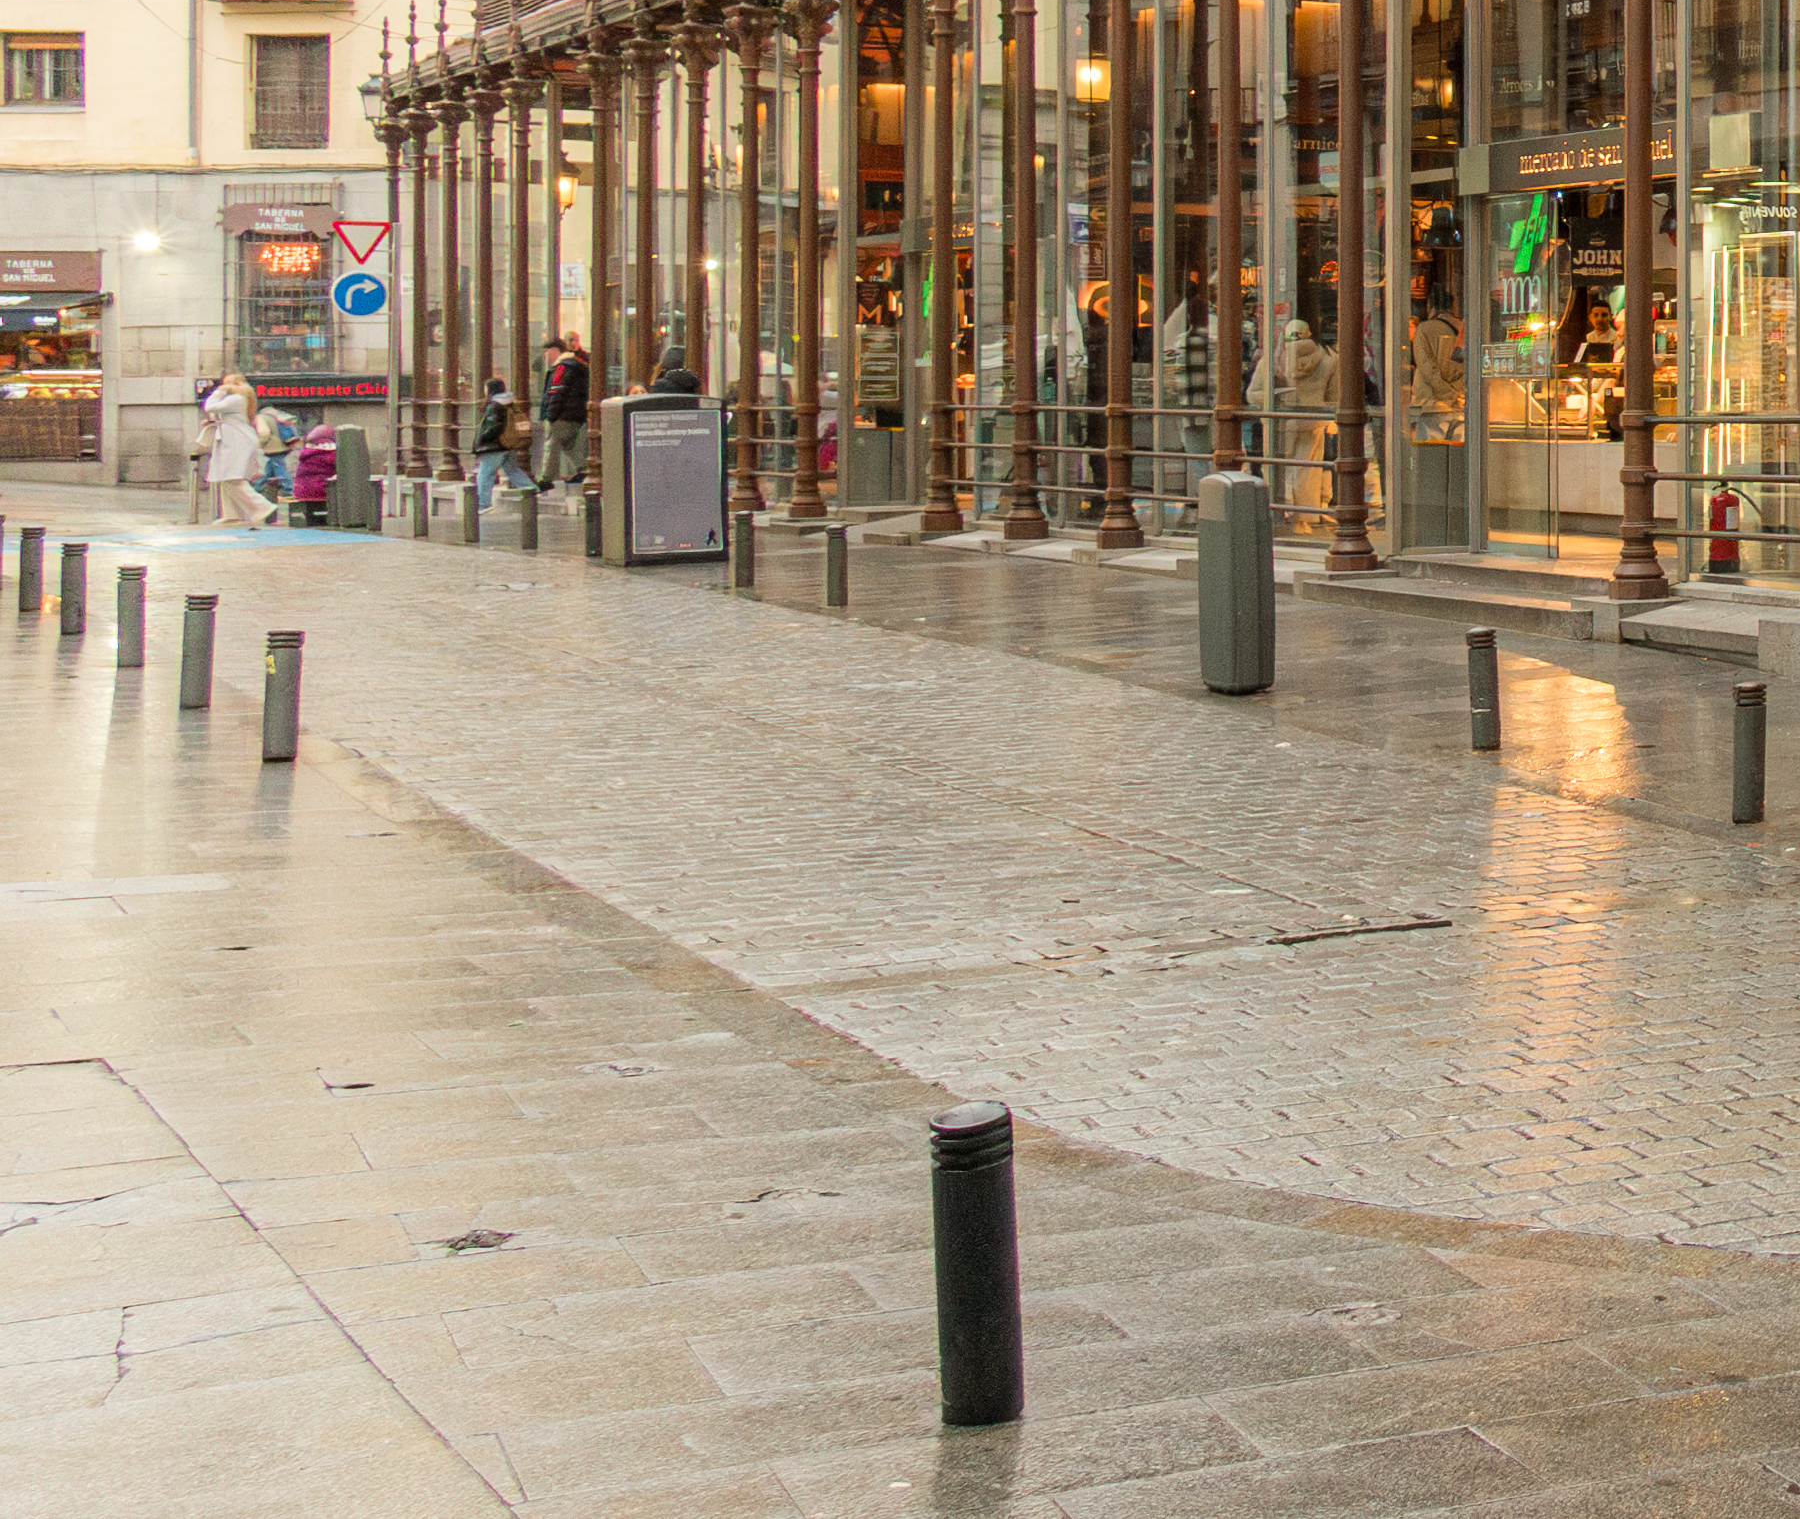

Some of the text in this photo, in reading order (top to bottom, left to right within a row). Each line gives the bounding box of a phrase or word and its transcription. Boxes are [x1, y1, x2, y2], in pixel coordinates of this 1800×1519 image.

[1597, 144, 1623, 166] san
[257, 208, 305, 218] TABERNA
[254, 222, 276, 232] SAN
[1572, 249, 1623, 265] JOHN
[6, 260, 54, 269] TABERNA
[2, 272, 25, 282] SAN
[256, 384, 352, 397] Restaurante
